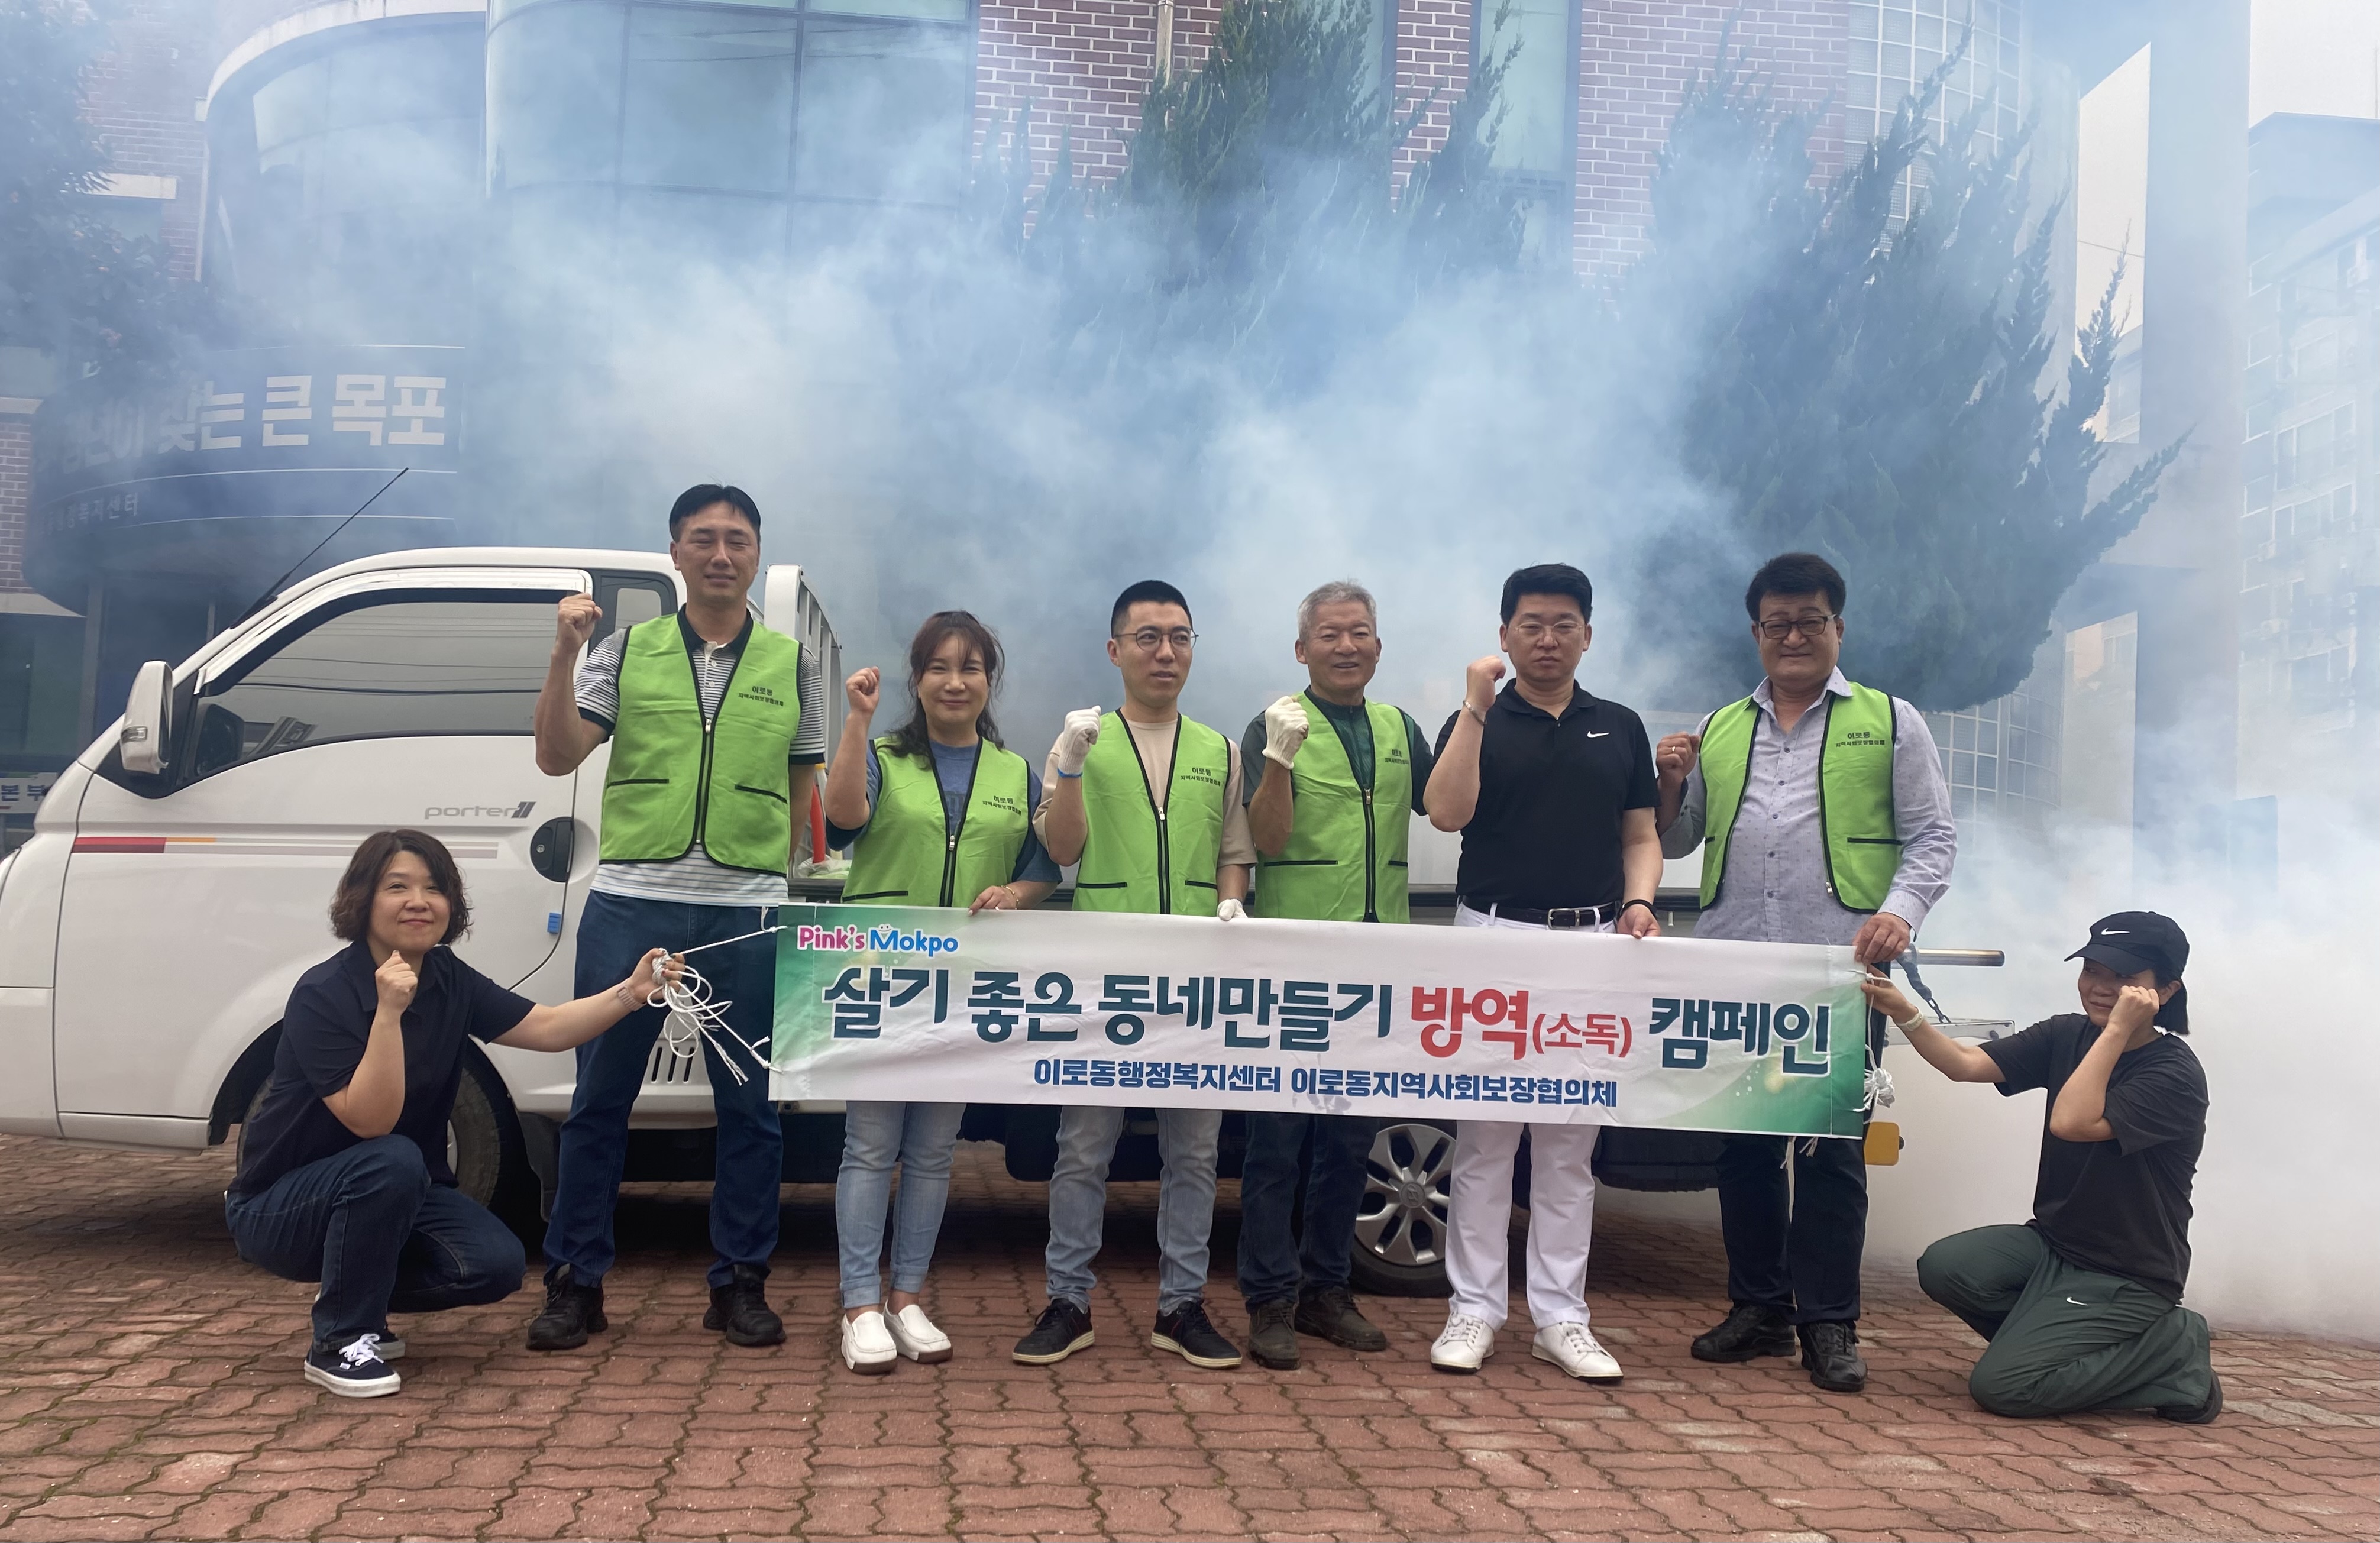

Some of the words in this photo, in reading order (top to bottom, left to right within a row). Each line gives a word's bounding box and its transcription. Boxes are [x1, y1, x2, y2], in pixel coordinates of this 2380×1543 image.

[261, 375, 312, 447] 큰
[332, 374, 447, 447] 목포
[799, 926, 865, 950] Pink's
[869, 929, 959, 957] Mokpo
[824, 968, 949, 1039] 살기
[968, 971, 1082, 1043] 좋은
[1098, 975, 1392, 1052] 동네만들기
[1412, 987, 1631, 1060] 방역(소독)
[1649, 998, 1829, 1074] 캠페인
[1034, 1059, 1280, 1093] 이로동행정복지센터
[1292, 1068, 1617, 1107] 이로동지역사회보장협의체
